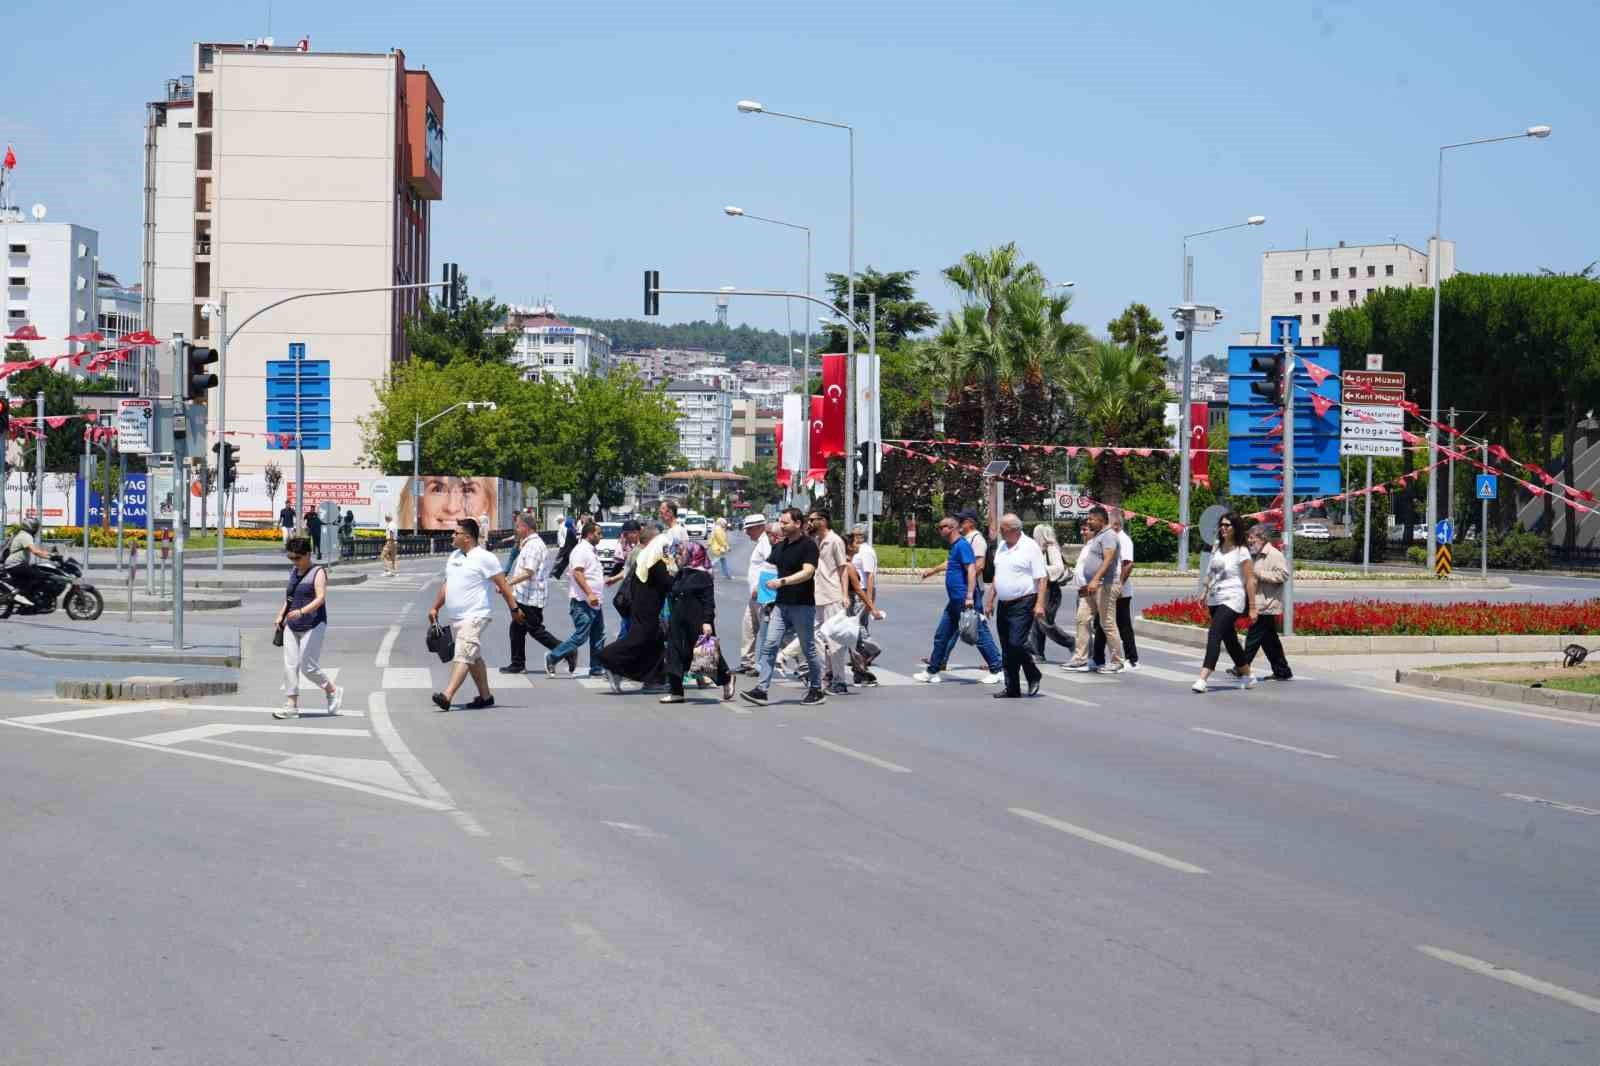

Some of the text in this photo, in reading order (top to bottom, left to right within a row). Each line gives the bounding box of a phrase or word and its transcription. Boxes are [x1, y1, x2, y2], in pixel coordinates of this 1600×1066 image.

[1375, 376, 1402, 384] Müzesi
[1355, 392, 1402, 401] Kent Müzesi
[1354, 427, 1387, 436] Otogar
[1354, 443, 1400, 453] Kütüphane
